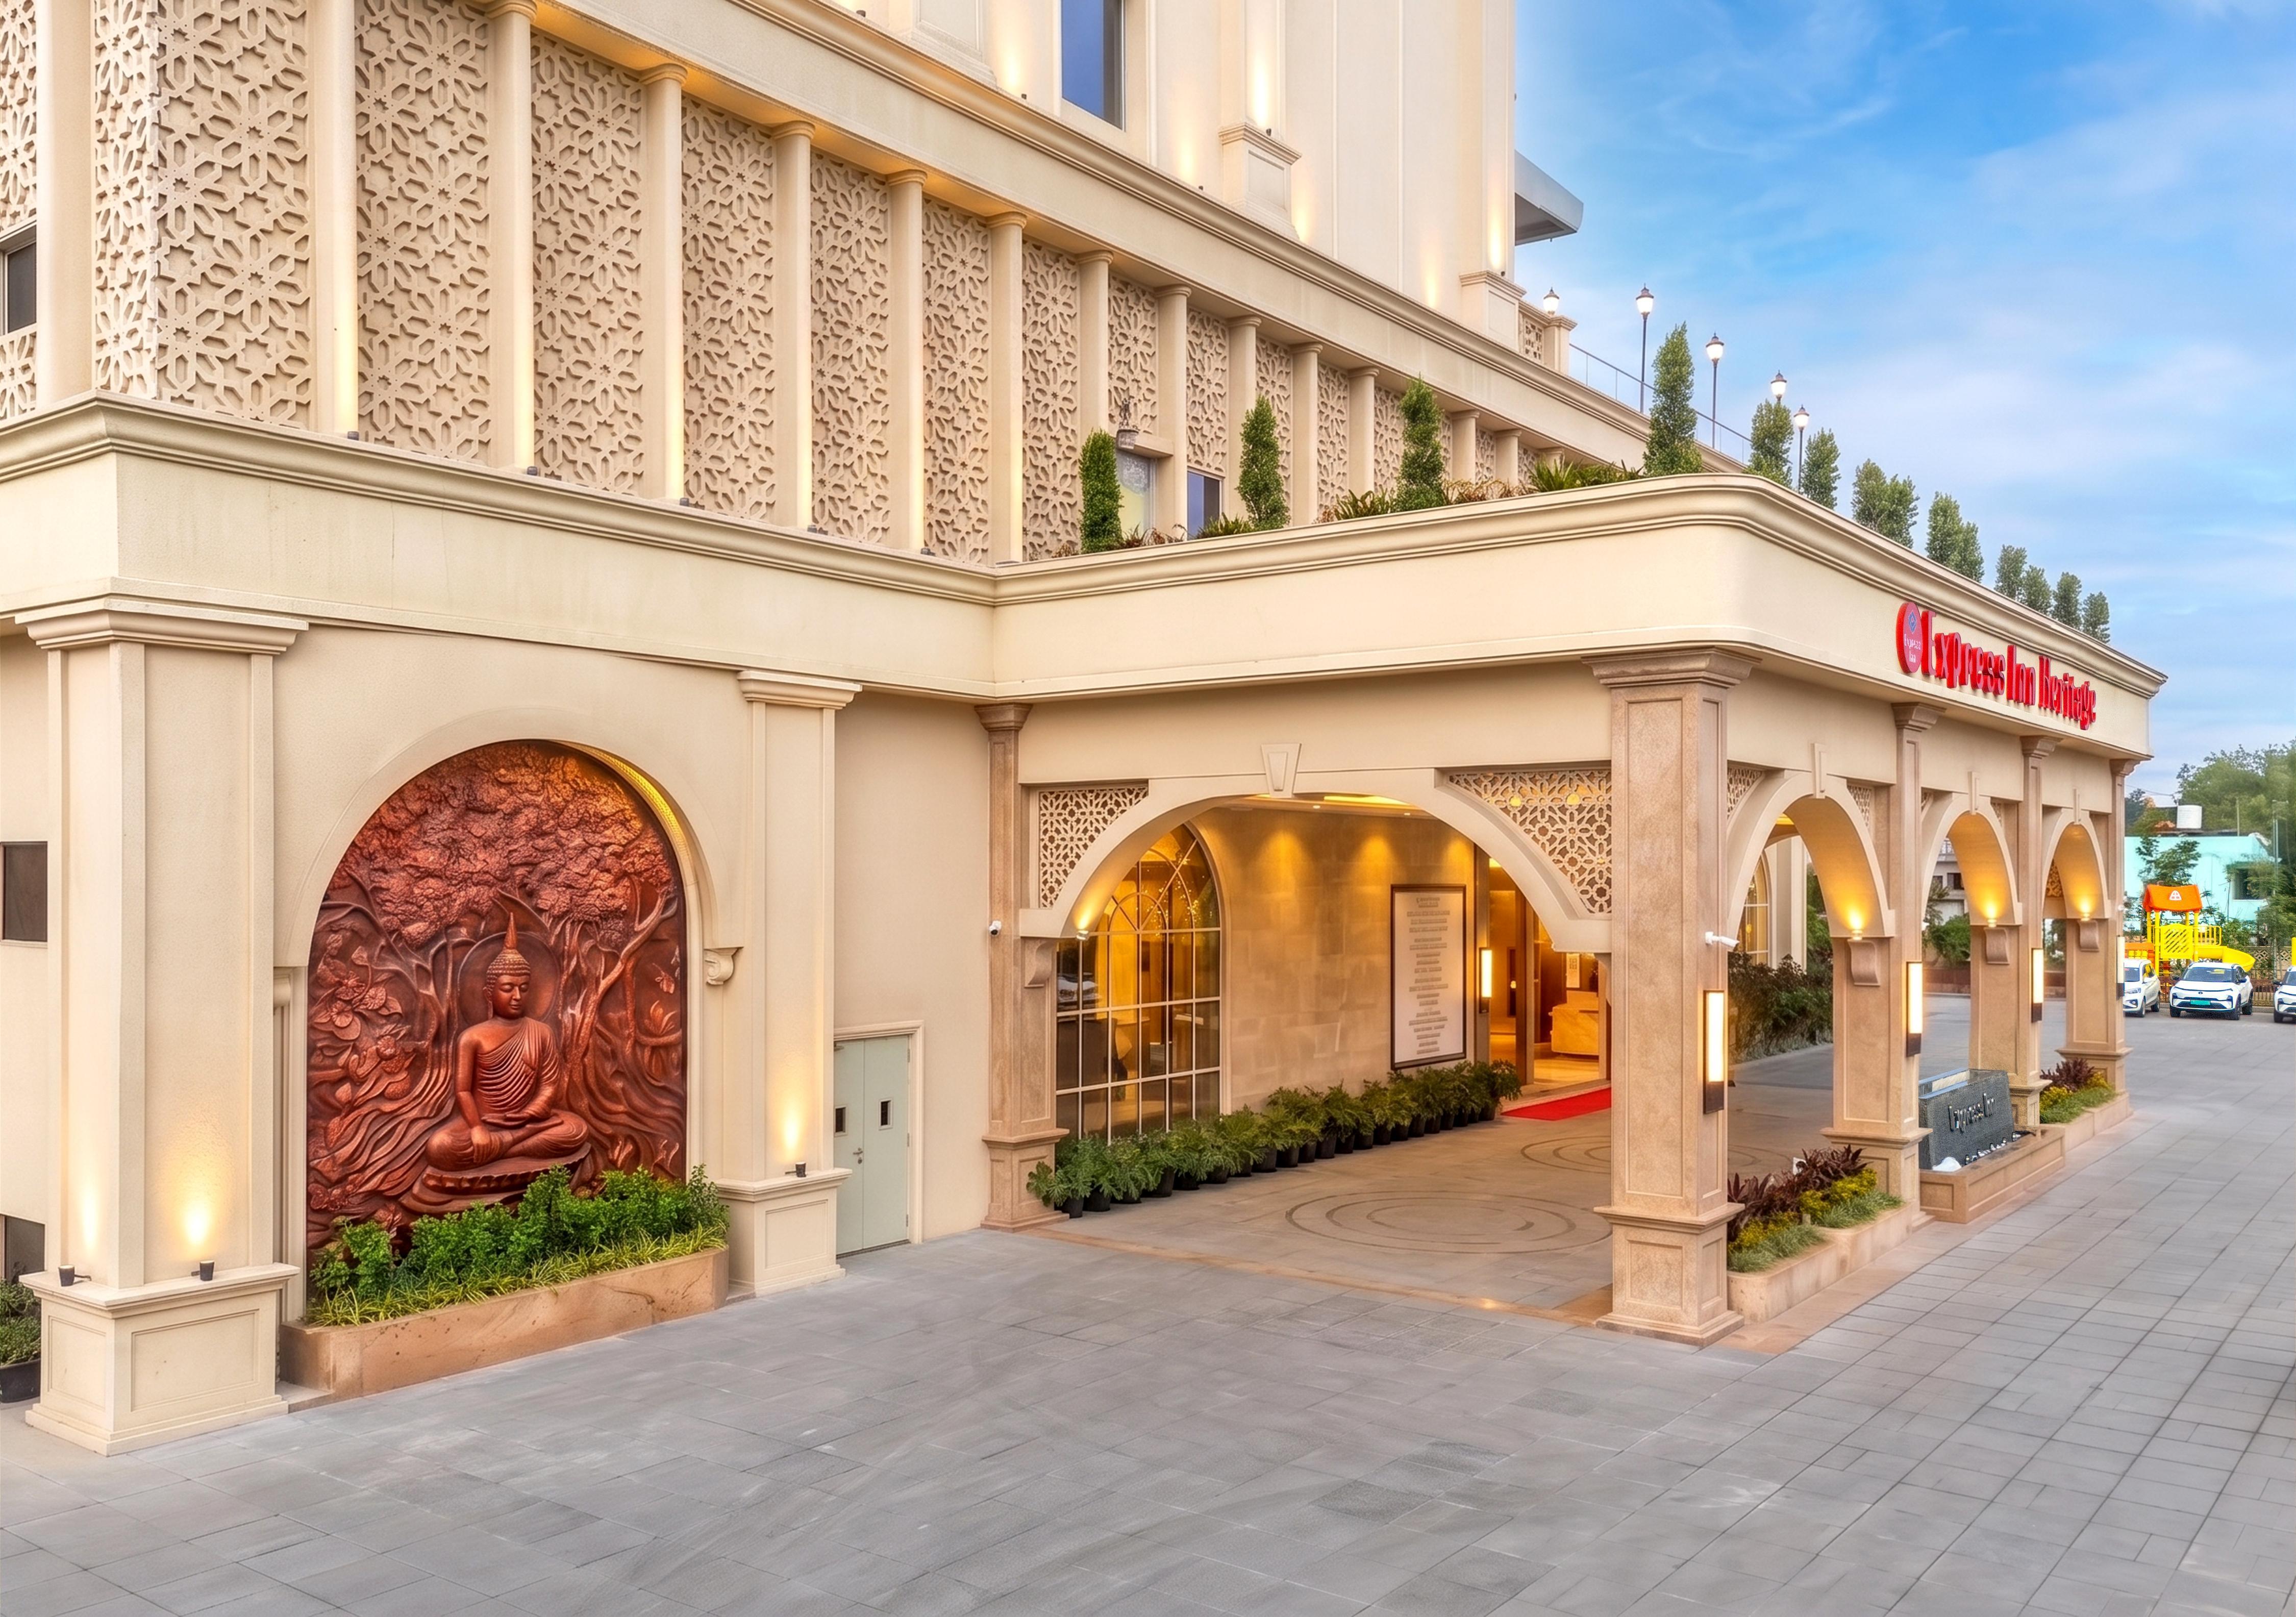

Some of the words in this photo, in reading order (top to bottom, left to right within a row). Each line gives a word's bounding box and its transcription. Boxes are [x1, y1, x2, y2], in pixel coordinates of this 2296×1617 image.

[1921, 610, 2006, 695] Express
[2006, 644, 2036, 706] Inn
[2038, 655, 2096, 731] Heritage
